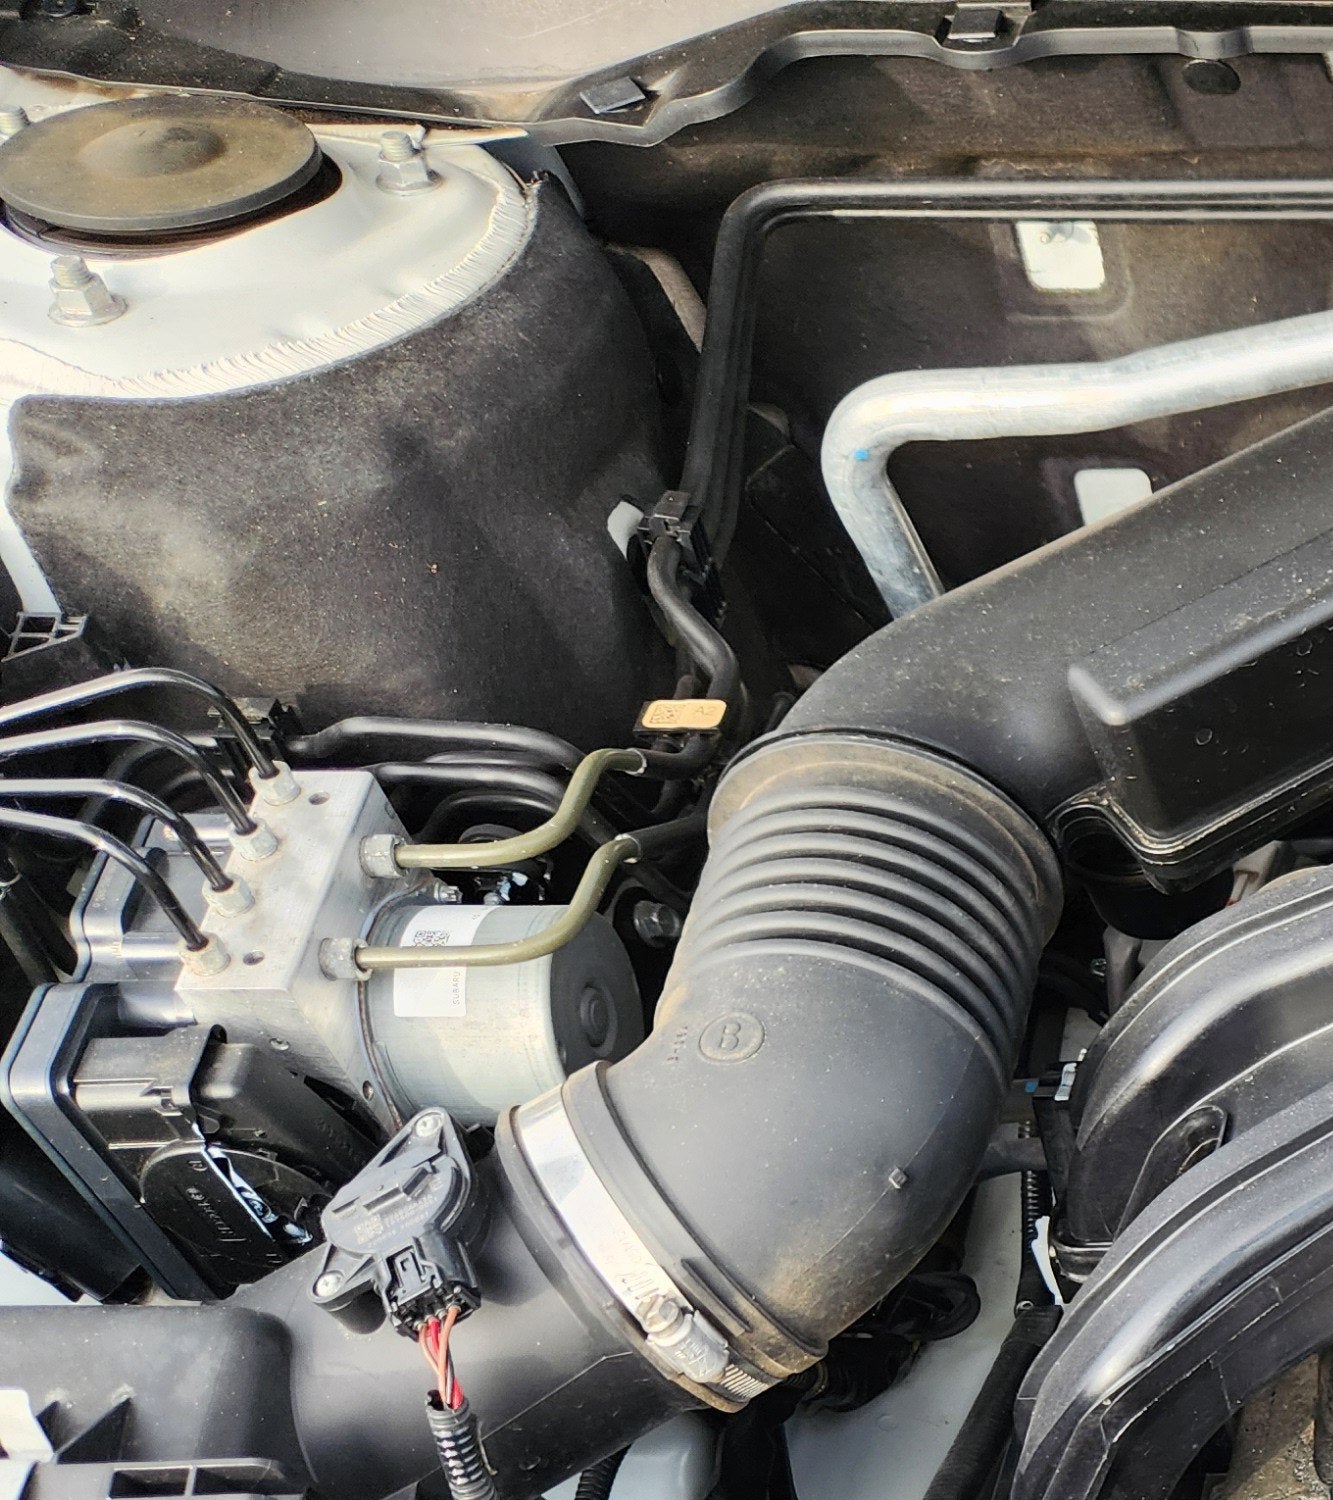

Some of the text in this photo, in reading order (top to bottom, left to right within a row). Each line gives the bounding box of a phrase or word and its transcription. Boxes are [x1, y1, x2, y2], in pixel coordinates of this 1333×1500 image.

[695, 705, 717, 716] A2
[452, 970, 461, 1006] SUBARU
[718, 1020, 742, 1051] B
